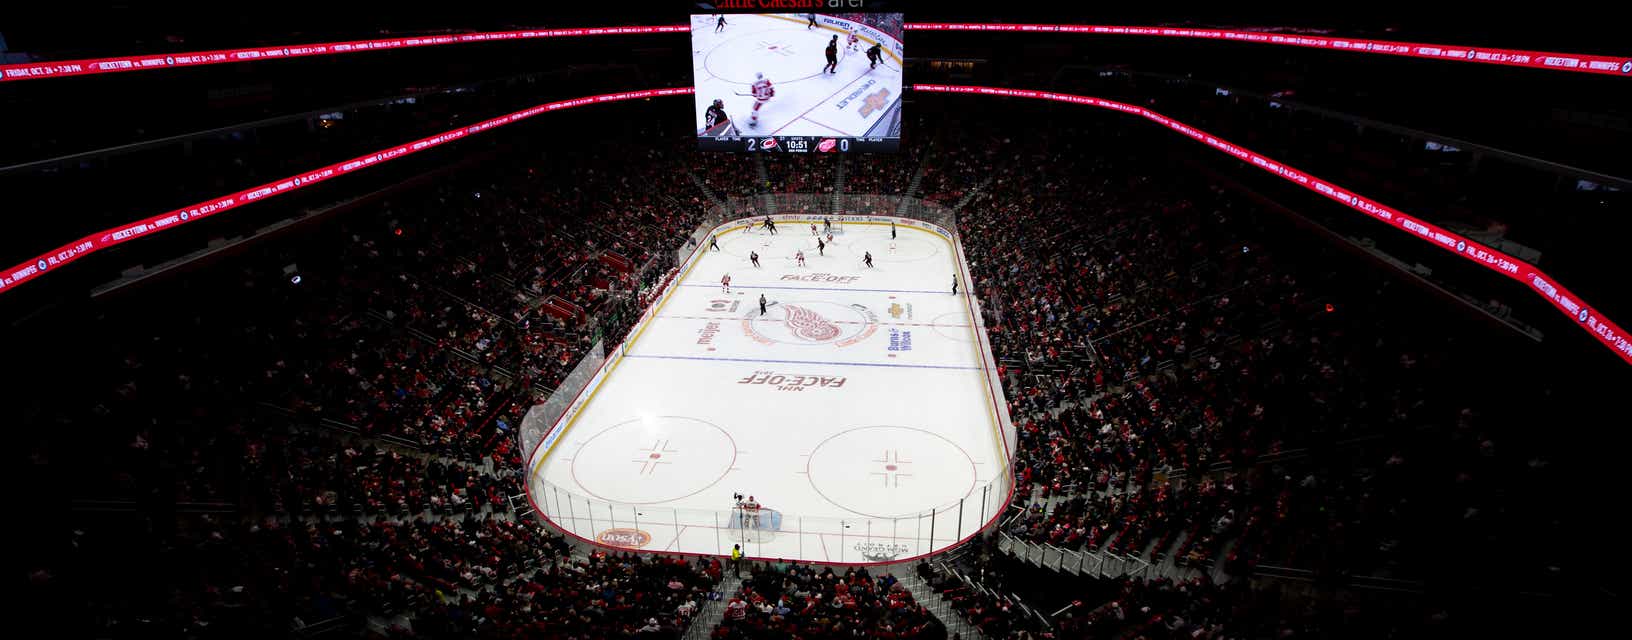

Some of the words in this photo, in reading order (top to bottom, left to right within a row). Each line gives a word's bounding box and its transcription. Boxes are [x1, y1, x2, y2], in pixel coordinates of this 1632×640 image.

[748, 138, 756, 151] 2
[786, 140, 808, 149] 10:51
[840, 139, 849, 151] 0
[737, 374, 846, 388] FACE-OFF
